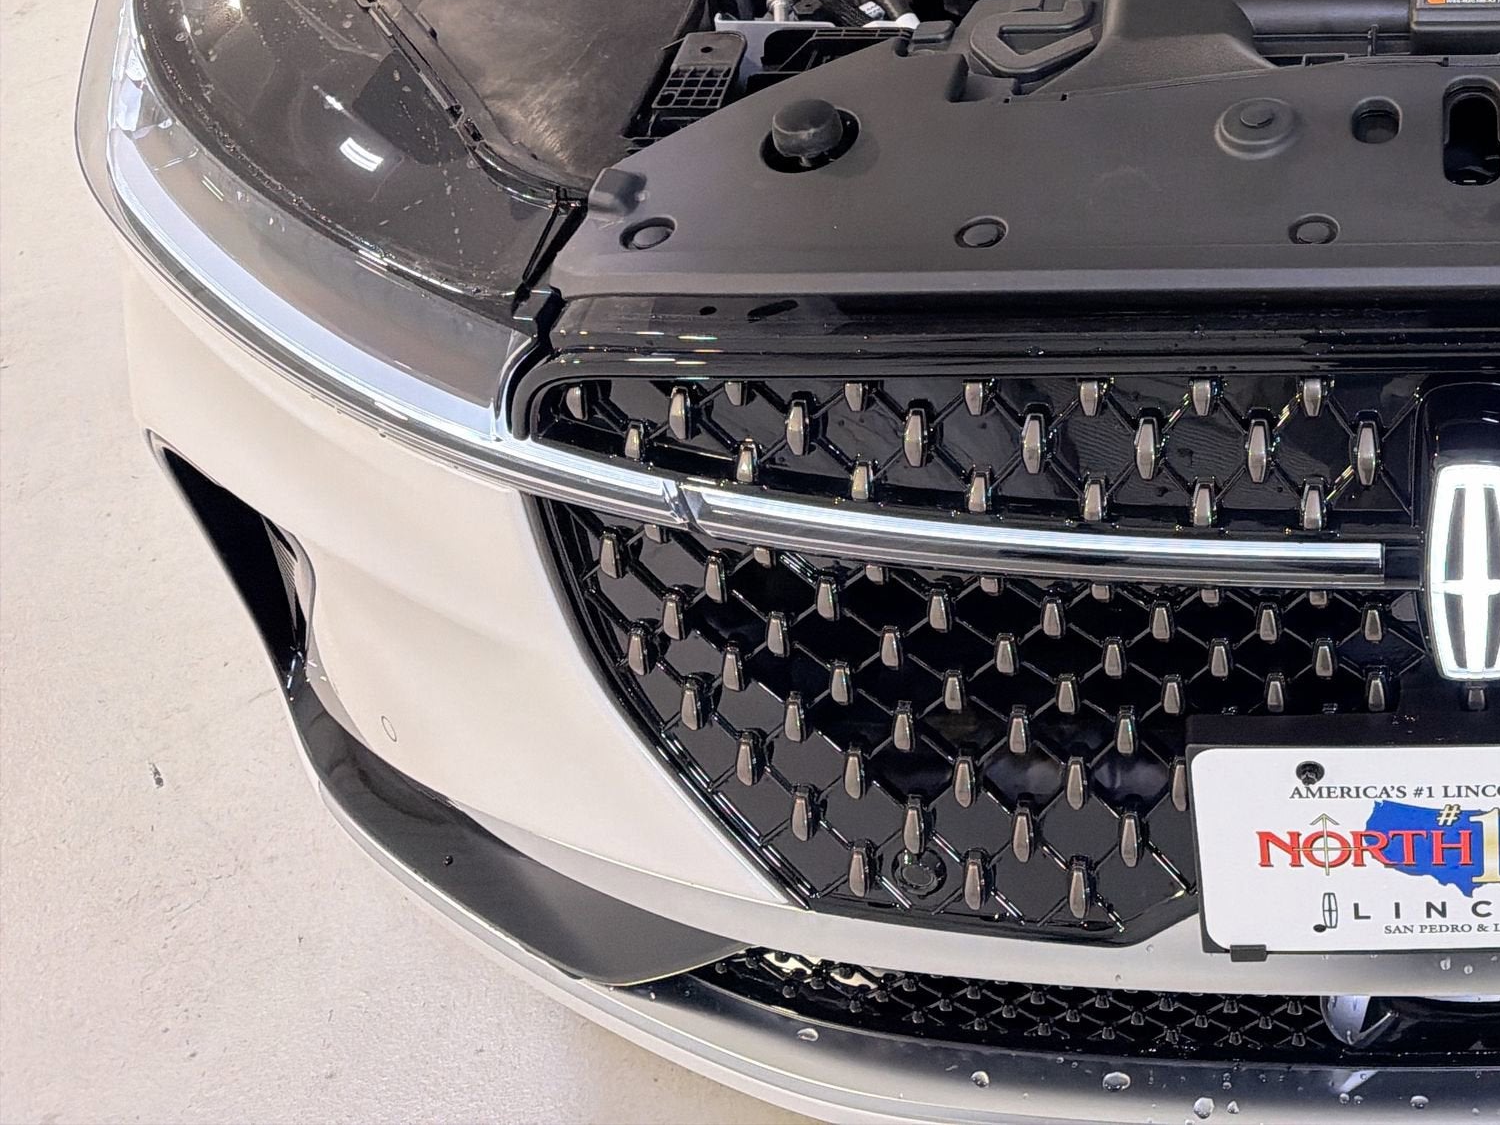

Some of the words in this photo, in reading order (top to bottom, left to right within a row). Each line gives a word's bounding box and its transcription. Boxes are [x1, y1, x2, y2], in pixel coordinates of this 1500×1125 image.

[1289, 784, 1407, 799] AMERICA'S
[1413, 785, 1435, 799] #1
[1255, 829, 1474, 869] NORTH
[1384, 923, 1415, 935] SAN
[1419, 922, 1473, 934] PEDRO
[1476, 922, 1489, 933] &
